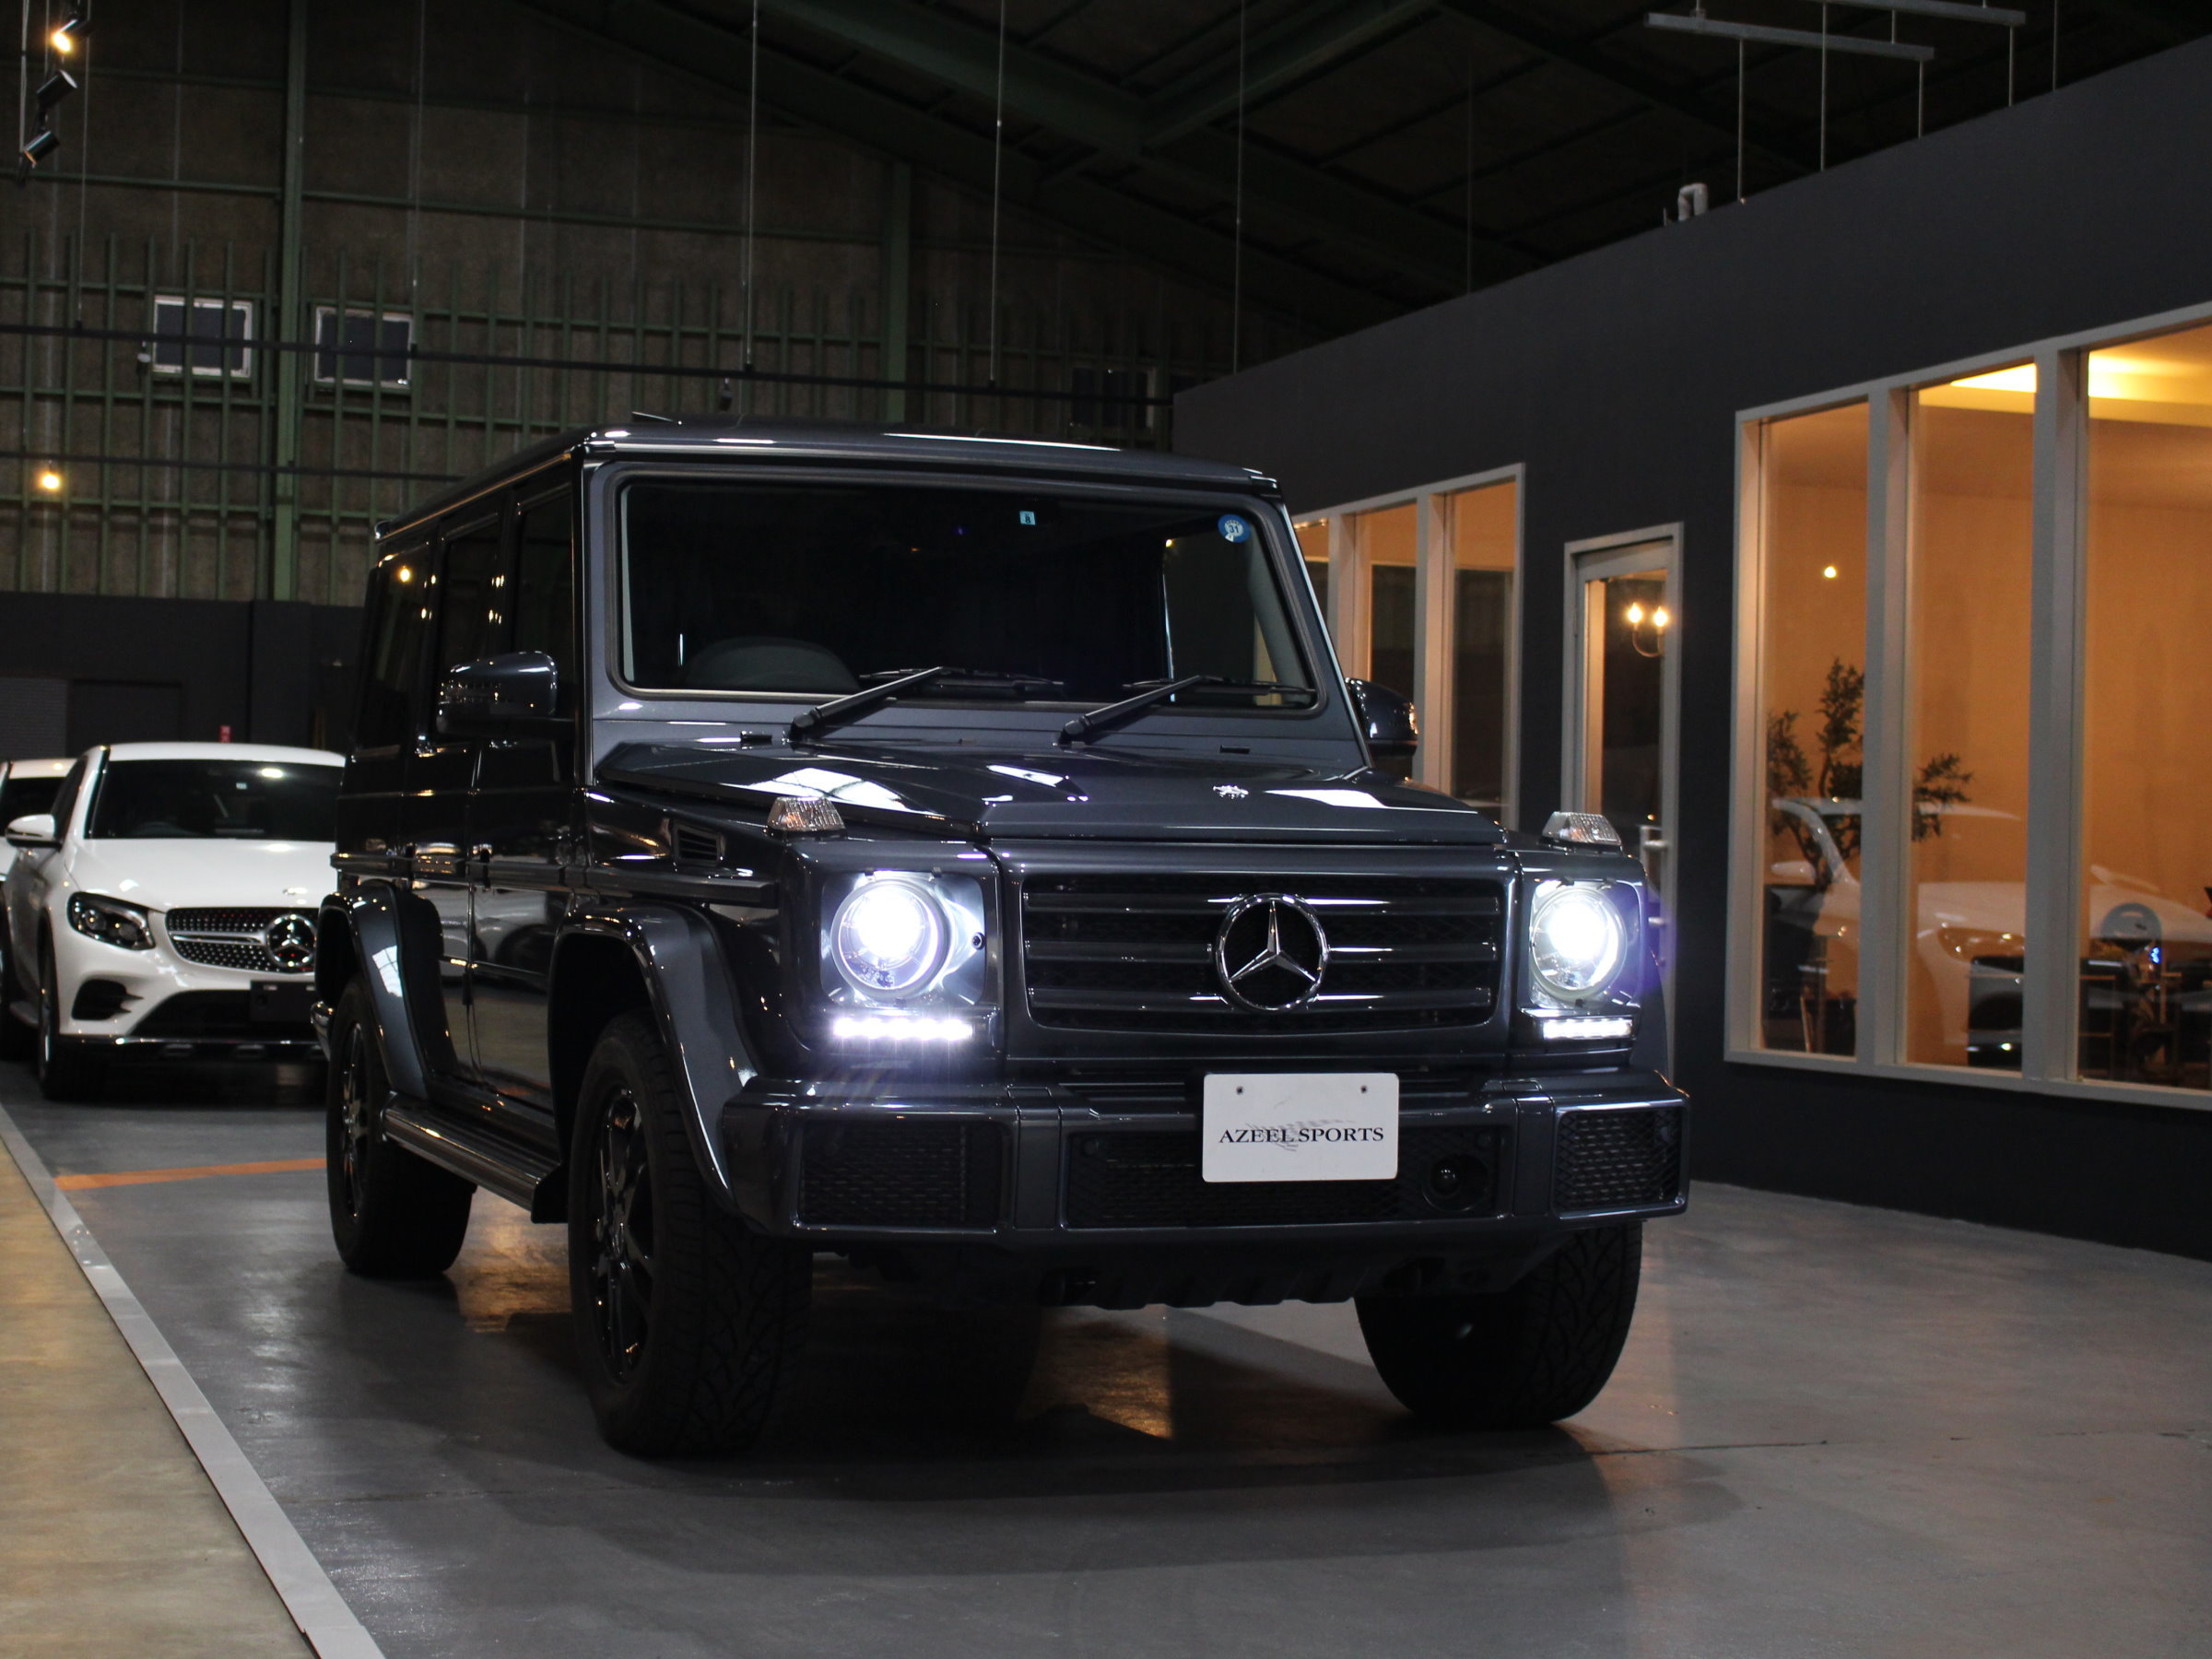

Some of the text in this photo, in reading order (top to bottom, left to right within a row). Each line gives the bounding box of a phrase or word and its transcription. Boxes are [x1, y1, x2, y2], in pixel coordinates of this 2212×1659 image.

[1229, 524, 1240, 534] 31
[1218, 1127, 1384, 1144] AZEEL SPORTS
